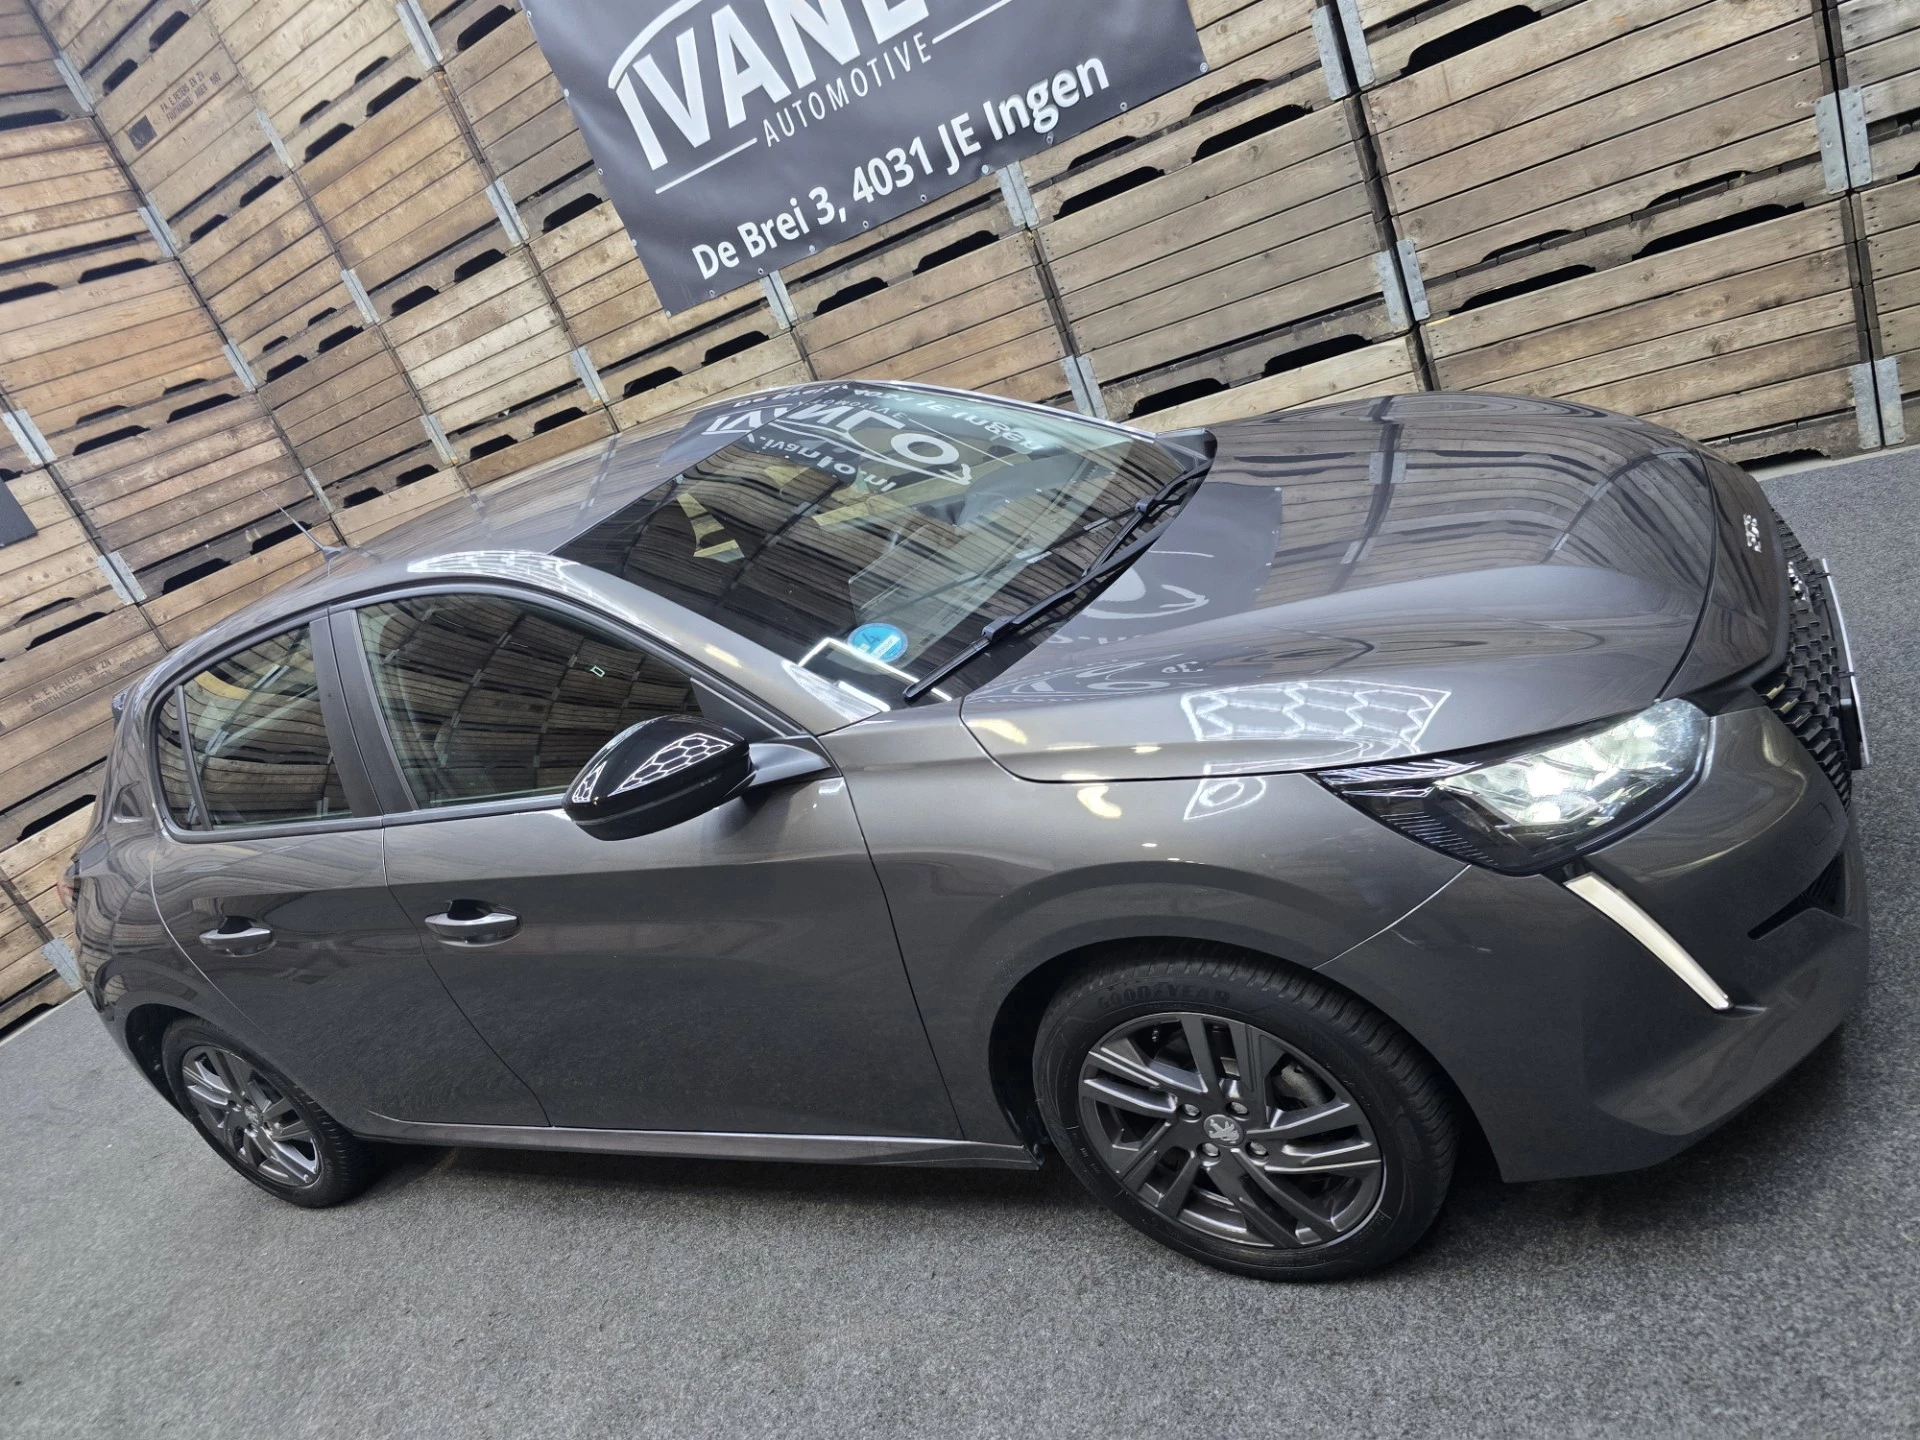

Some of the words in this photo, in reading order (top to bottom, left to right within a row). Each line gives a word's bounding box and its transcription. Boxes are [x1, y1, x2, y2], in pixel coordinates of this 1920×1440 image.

[691, 241, 740, 280] De
[736, 197, 810, 258] Brei
[808, 187, 847, 226] 3,
[852, 136, 934, 203] 4031
[937, 112, 982, 176] JE
[982, 57, 1110, 134] Ingen
[763, 32, 932, 147] AUTOMOTIVE
